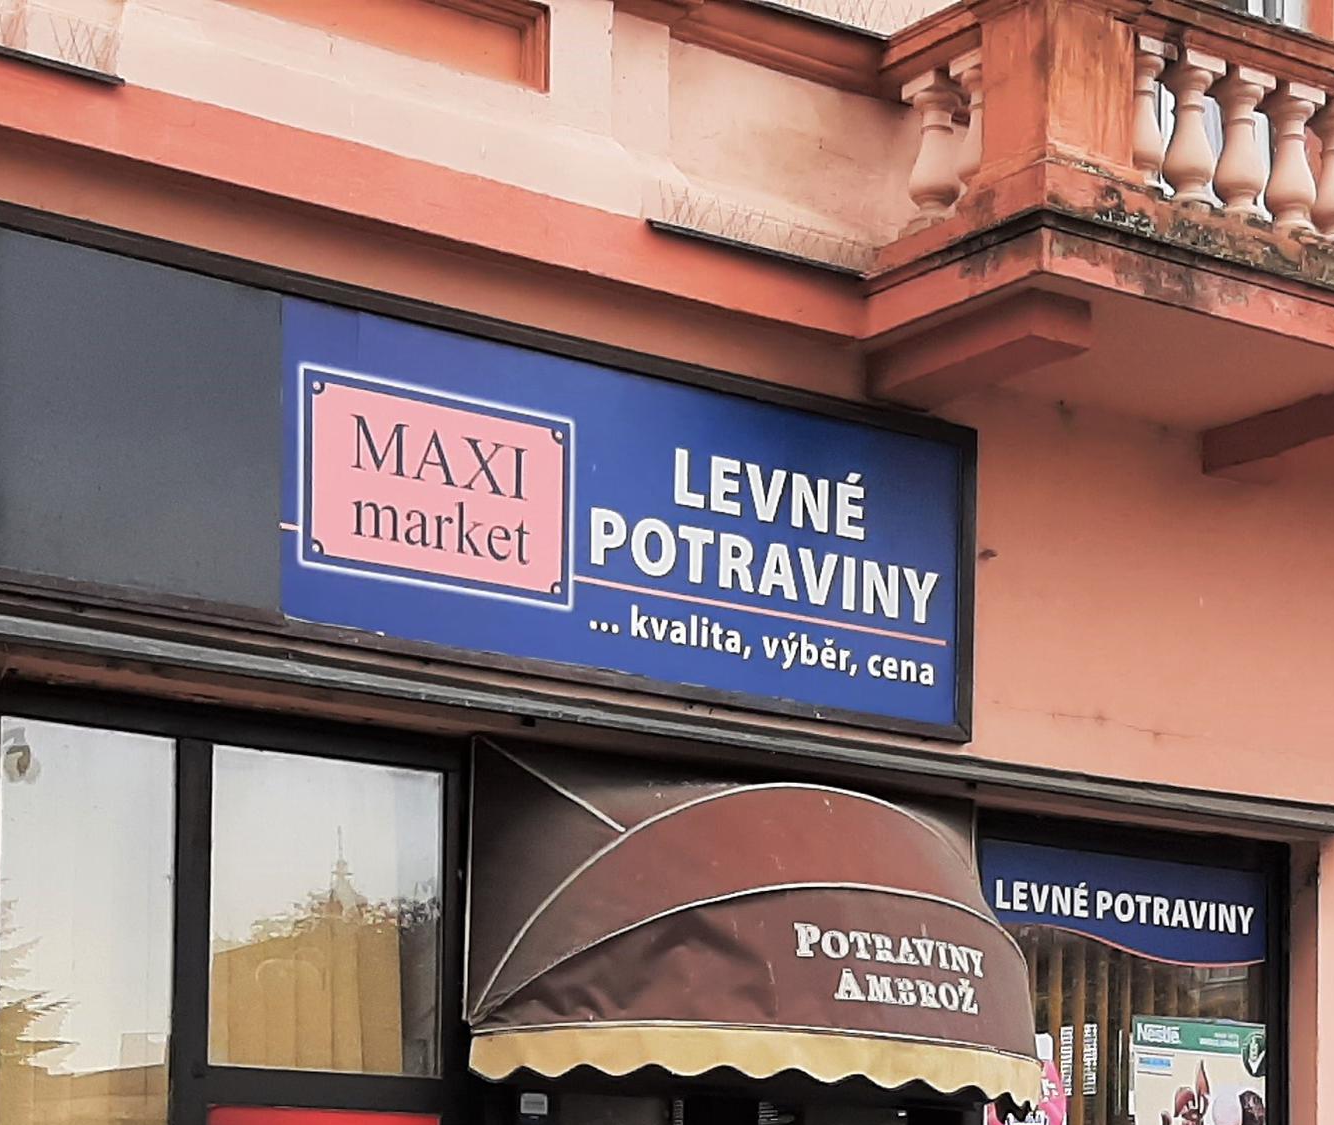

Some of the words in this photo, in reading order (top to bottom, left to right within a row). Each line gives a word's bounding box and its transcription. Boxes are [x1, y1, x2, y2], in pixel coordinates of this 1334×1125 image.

[352, 415, 529, 500] MAXI
[674, 447, 866, 541] LEVNÉ
[353, 497, 530, 565] market
[589, 506, 939, 624] POTRAVINY
[630, 604, 751, 660] kvalita,
[762, 628, 858, 677] výběr,
[867, 653, 934, 686] cena
[995, 879, 1089, 918] LEVNÉ
[1096, 890, 1255, 935] POTRAVINY
[793, 921, 985, 978] POTRAVINY
[833, 967, 979, 1015] AMBROŽ
